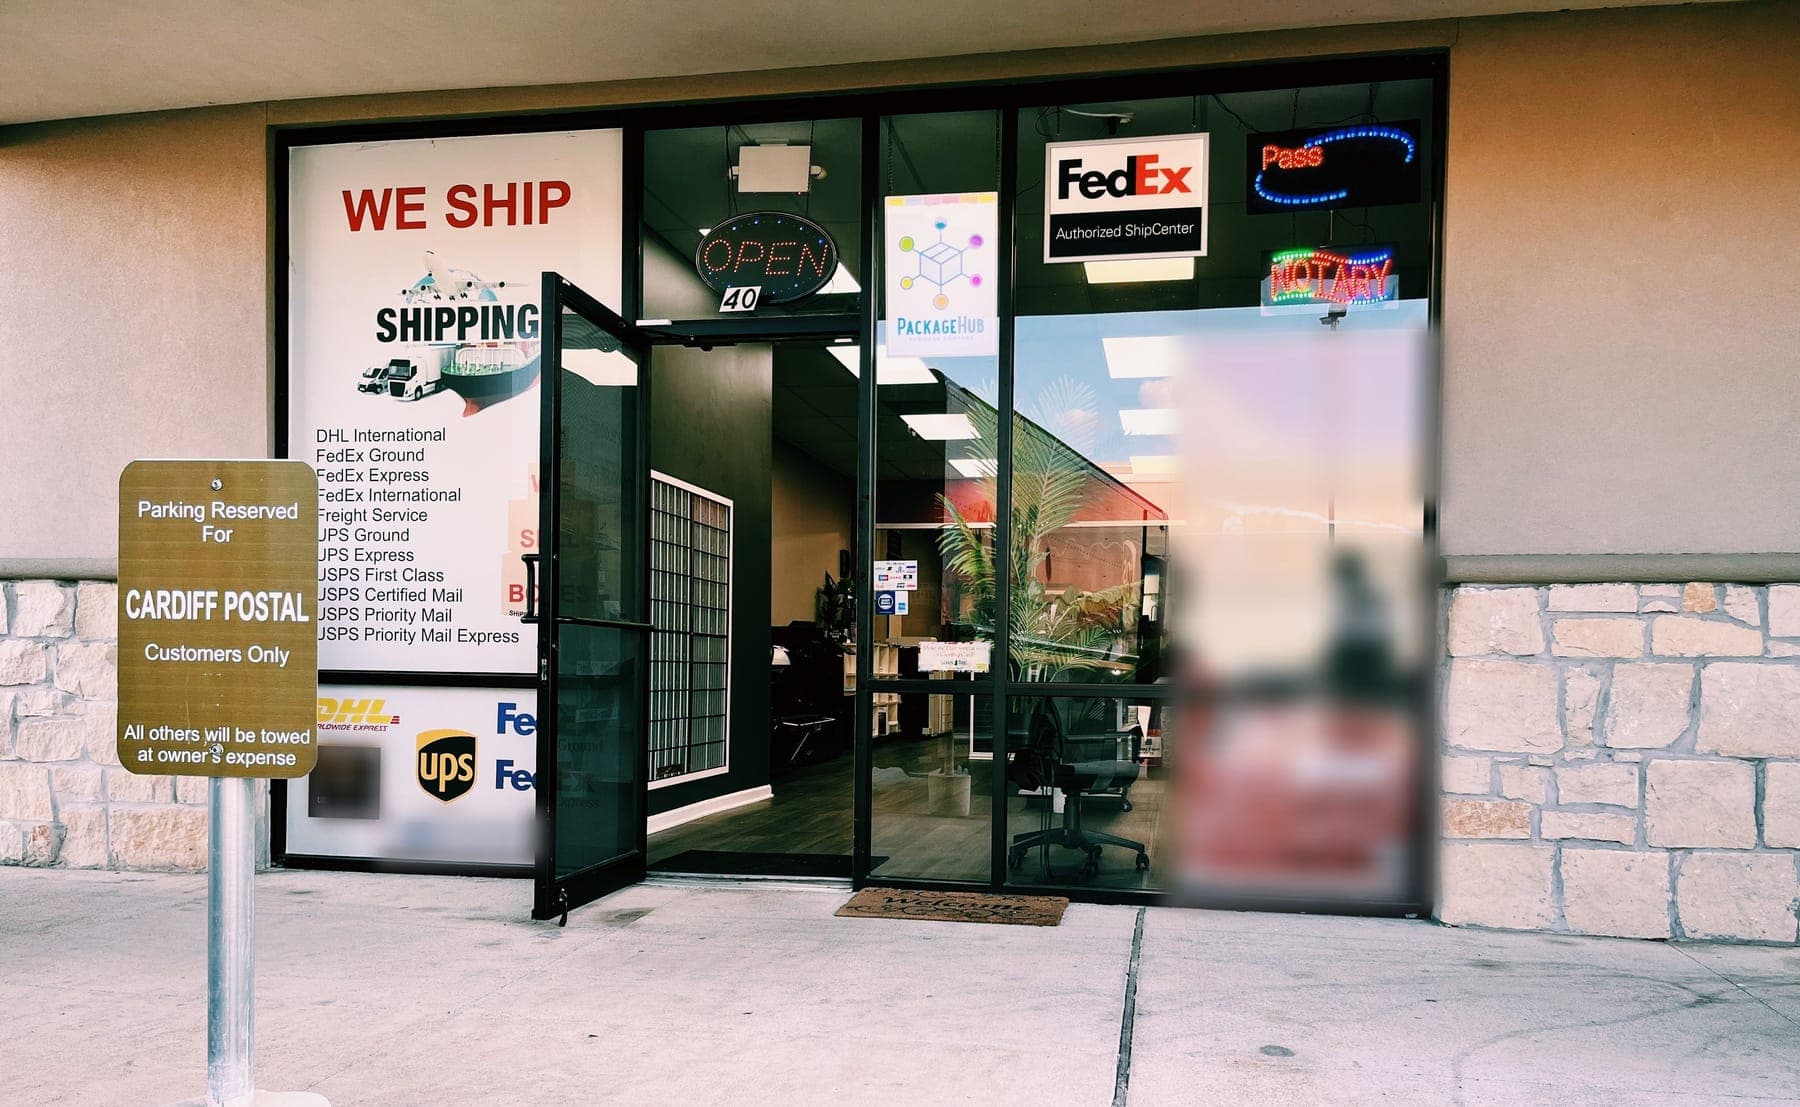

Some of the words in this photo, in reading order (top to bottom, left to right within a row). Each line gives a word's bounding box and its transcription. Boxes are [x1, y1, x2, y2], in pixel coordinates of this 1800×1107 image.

[1262, 144, 1323, 171] Pass
[1058, 153, 1193, 200] FedEx
[342, 186, 427, 232] WE
[445, 180, 572, 229] SHIP
[1056, 224, 1122, 241] Authorized
[1125, 222, 1194, 238] ShipCenter
[703, 238, 829, 277] OPEN
[1270, 259, 1392, 300] NOTARY
[722, 288, 758, 310] 40
[376, 303, 539, 343] SHIPPING
[316, 428, 349, 443] DHL
[354, 427, 446, 442] International
[316, 448, 364, 462] FedEx
[369, 448, 424, 462] Ground
[317, 468, 364, 482] FedEx
[369, 468, 430, 485] Express
[369, 488, 461, 502] International
[138, 501, 205, 522] Parking
[211, 502, 298, 520] Reserved
[372, 508, 428, 522] Service
[202, 526, 233, 543] For
[354, 528, 409, 542] Ground
[354, 548, 415, 565] Express
[365, 568, 398, 582] First
[402, 567, 444, 582] Class
[364, 587, 427, 602] Certified
[432, 588, 463, 603] Mail
[126, 589, 218, 620] CARDIFF
[224, 591, 310, 622] POSTAL
[365, 607, 417, 626] Priority
[421, 608, 452, 623] Mail
[364, 627, 417, 646] Priority
[421, 628, 452, 643] Mail
[457, 628, 520, 645] Express
[144, 644, 242, 663] Customers
[247, 646, 290, 667] Only
[124, 724, 144, 740] All
[149, 726, 200, 741] others
[205, 727, 230, 742] will
[235, 727, 256, 743] be
[261, 729, 311, 744] towed
[138, 747, 153, 762] at
[157, 746, 222, 764] owners
[226, 751, 297, 768] expense
